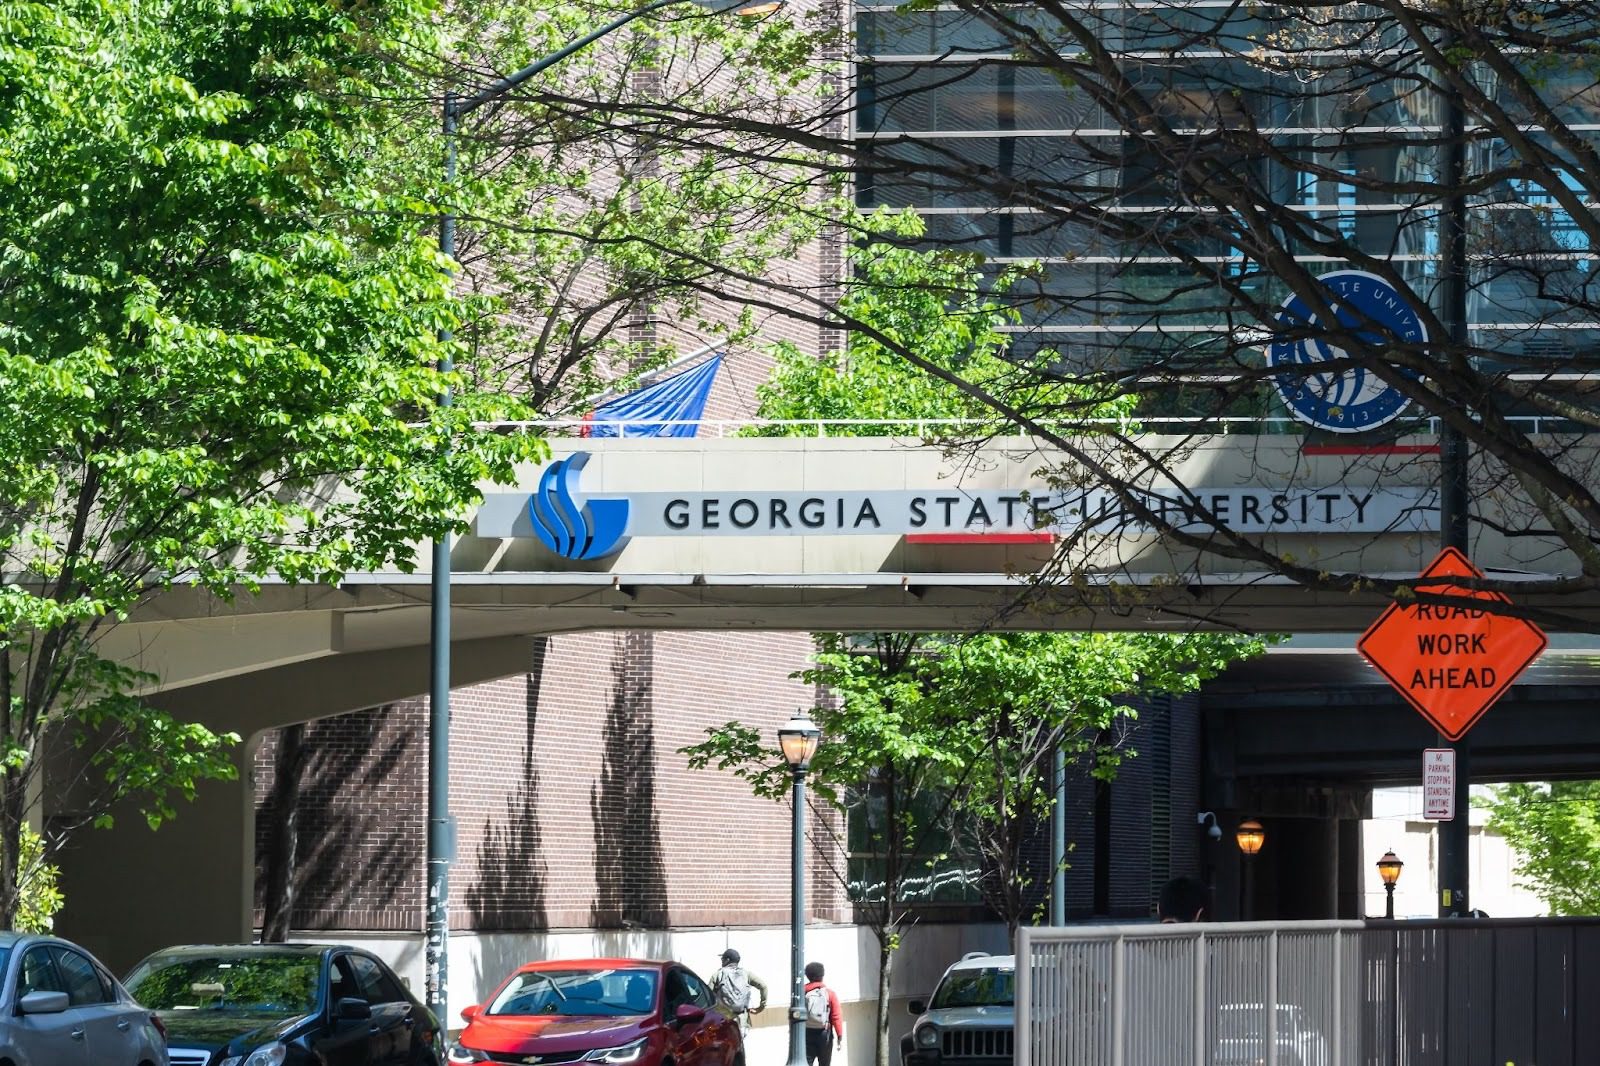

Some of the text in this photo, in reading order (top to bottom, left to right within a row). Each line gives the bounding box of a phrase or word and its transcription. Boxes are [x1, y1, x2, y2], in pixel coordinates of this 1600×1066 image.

[663, 497, 881, 530] GEORGIA
[909, 496, 1050, 528] STATE
[1417, 633, 1487, 655] WORK
[1410, 667, 1497, 690] AHEAD
[1428, 764, 1450, 773] PARKING
[1427, 775, 1451, 785] STOPPING
[1427, 787, 1451, 796] STANDING
[1428, 799, 1449, 807] ANYTIME
